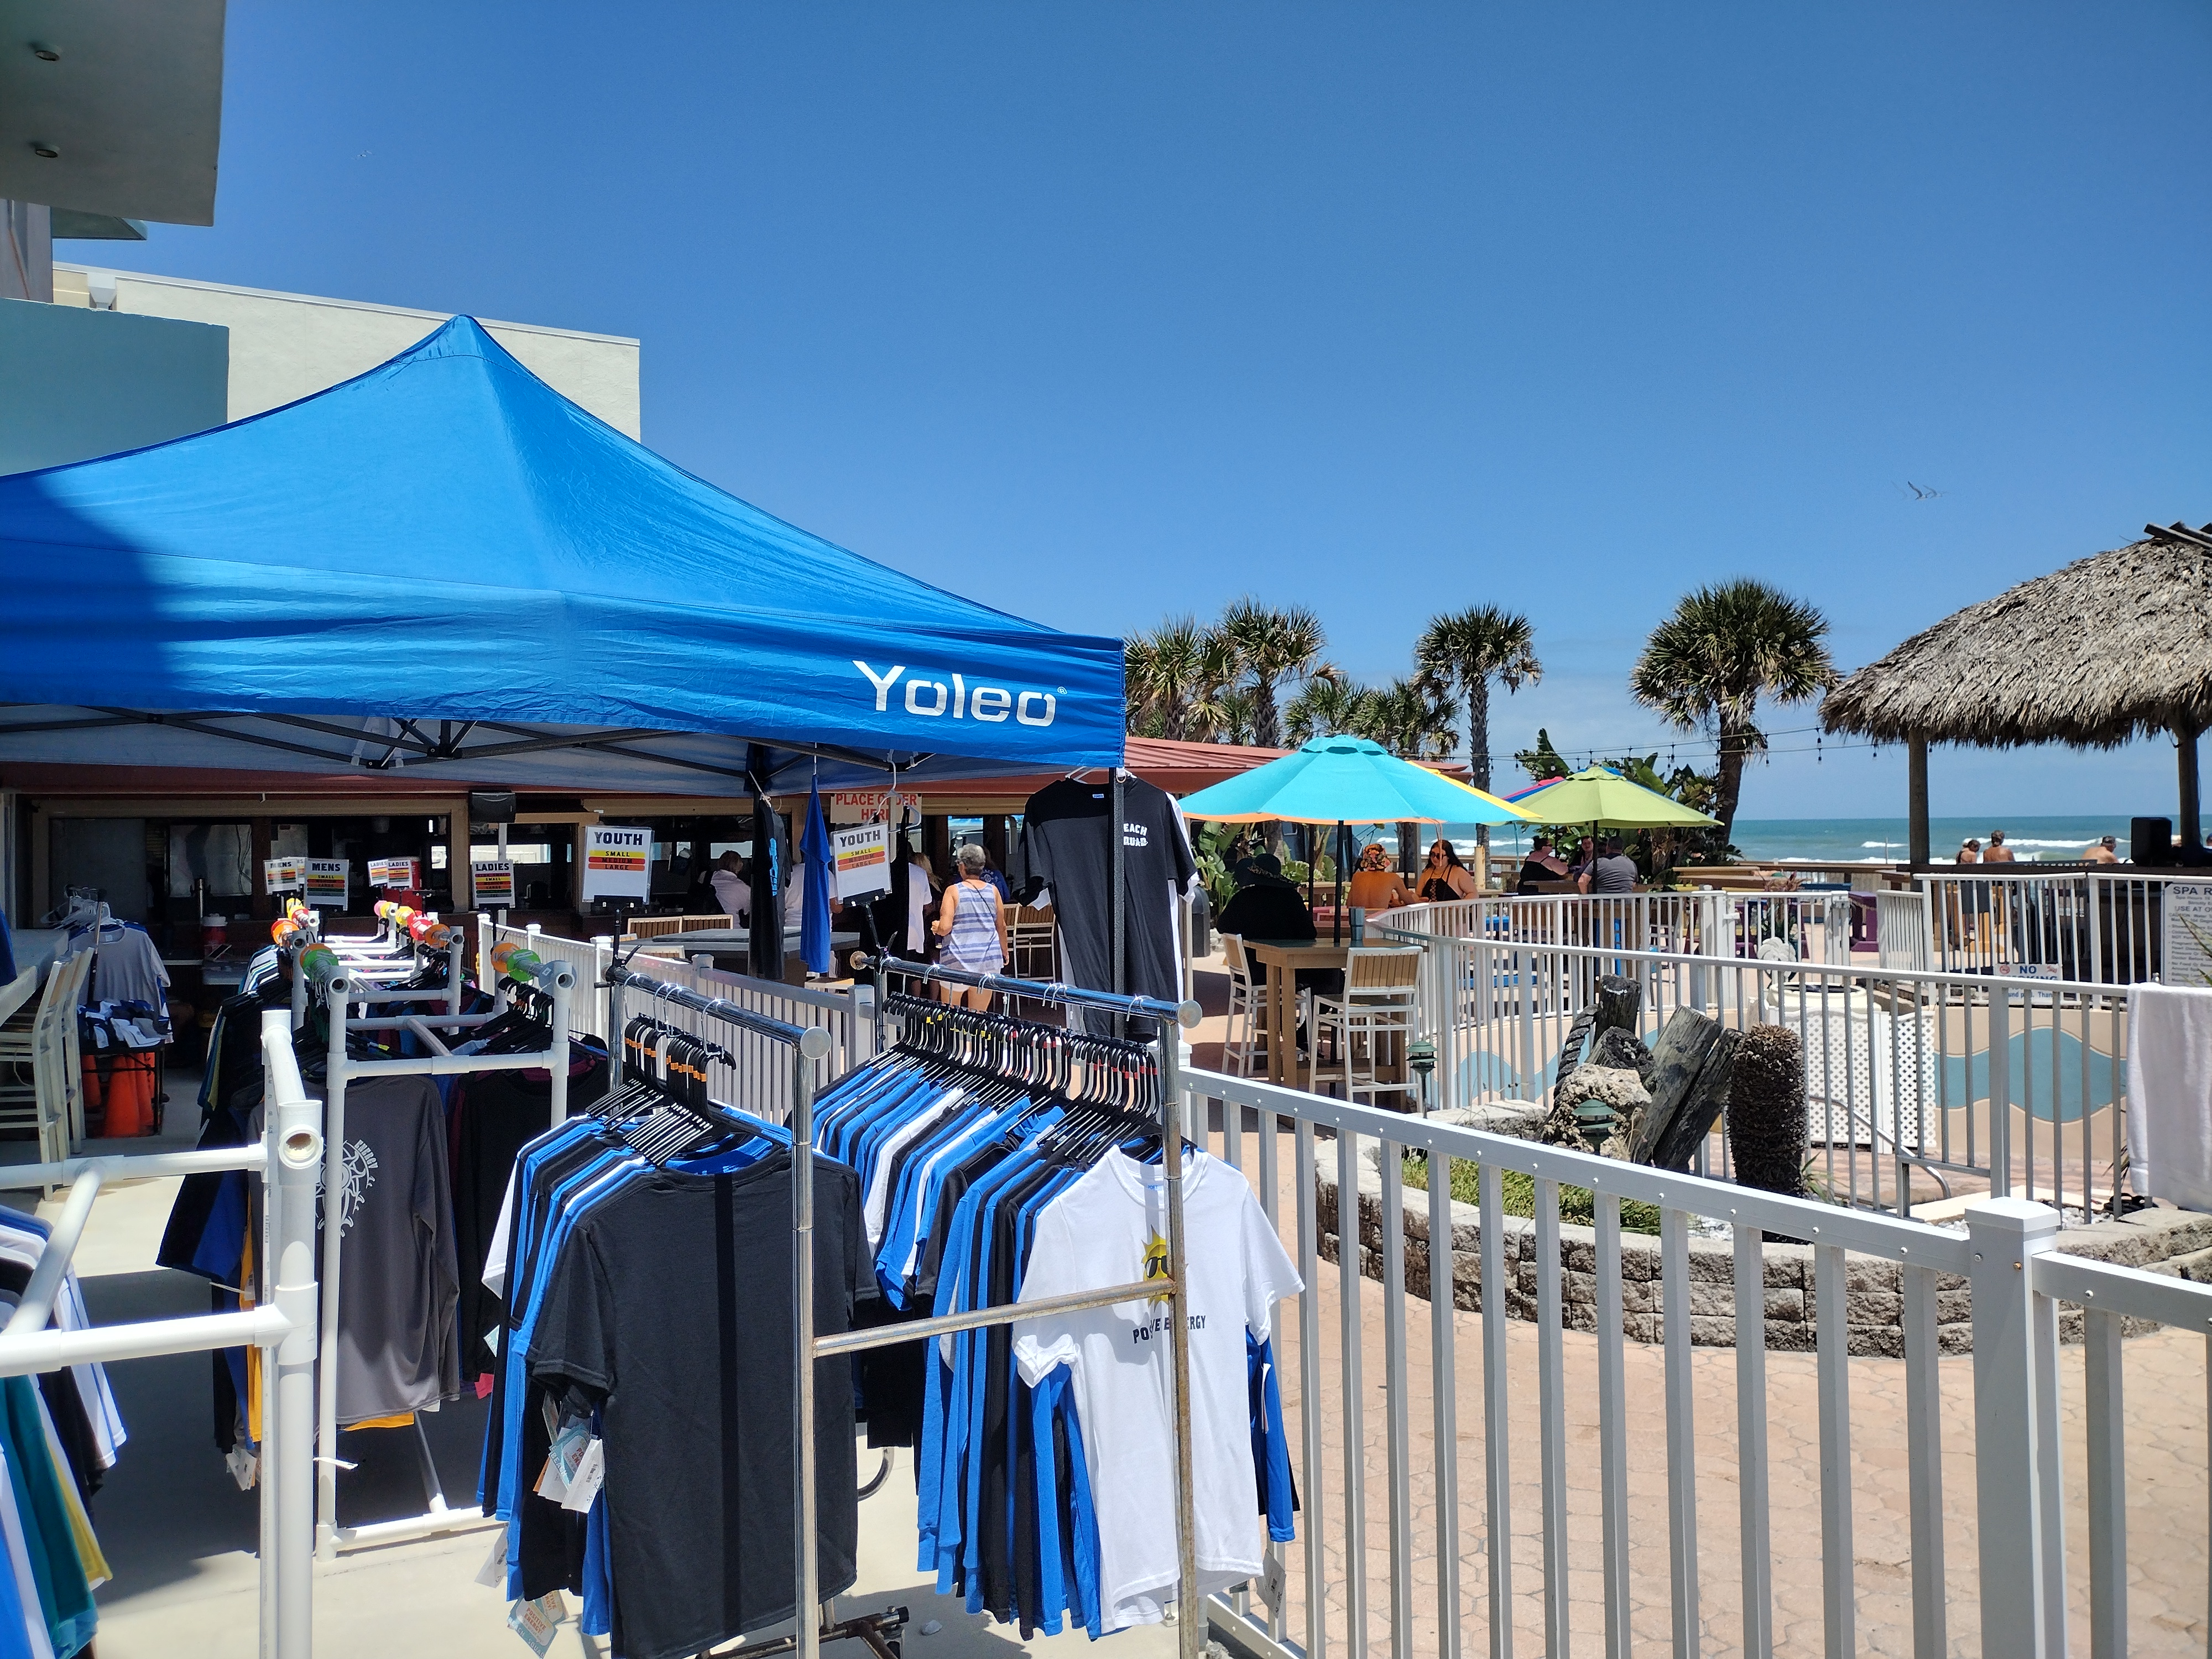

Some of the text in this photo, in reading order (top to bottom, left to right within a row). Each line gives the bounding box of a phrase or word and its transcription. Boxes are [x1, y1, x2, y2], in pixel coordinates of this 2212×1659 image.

[852, 660, 1056, 727] Yoleo
[836, 794, 874, 805] PLACE
[1124, 823, 1147, 836] EACH
[594, 832, 643, 845] YOUTH
[839, 830, 881, 847] YOUTH
[1124, 836, 1148, 847] QUAD
[851, 848, 872, 856] SMALL
[312, 863, 341, 872] MENS
[2173, 886, 2198, 895] SPA
[2020, 966, 2037, 974] NO
[354, 1139, 379, 1169] ENERGY
[526, 1606, 547, 1631] POSITIVE
[508, 1616, 525, 1638] BEACH
